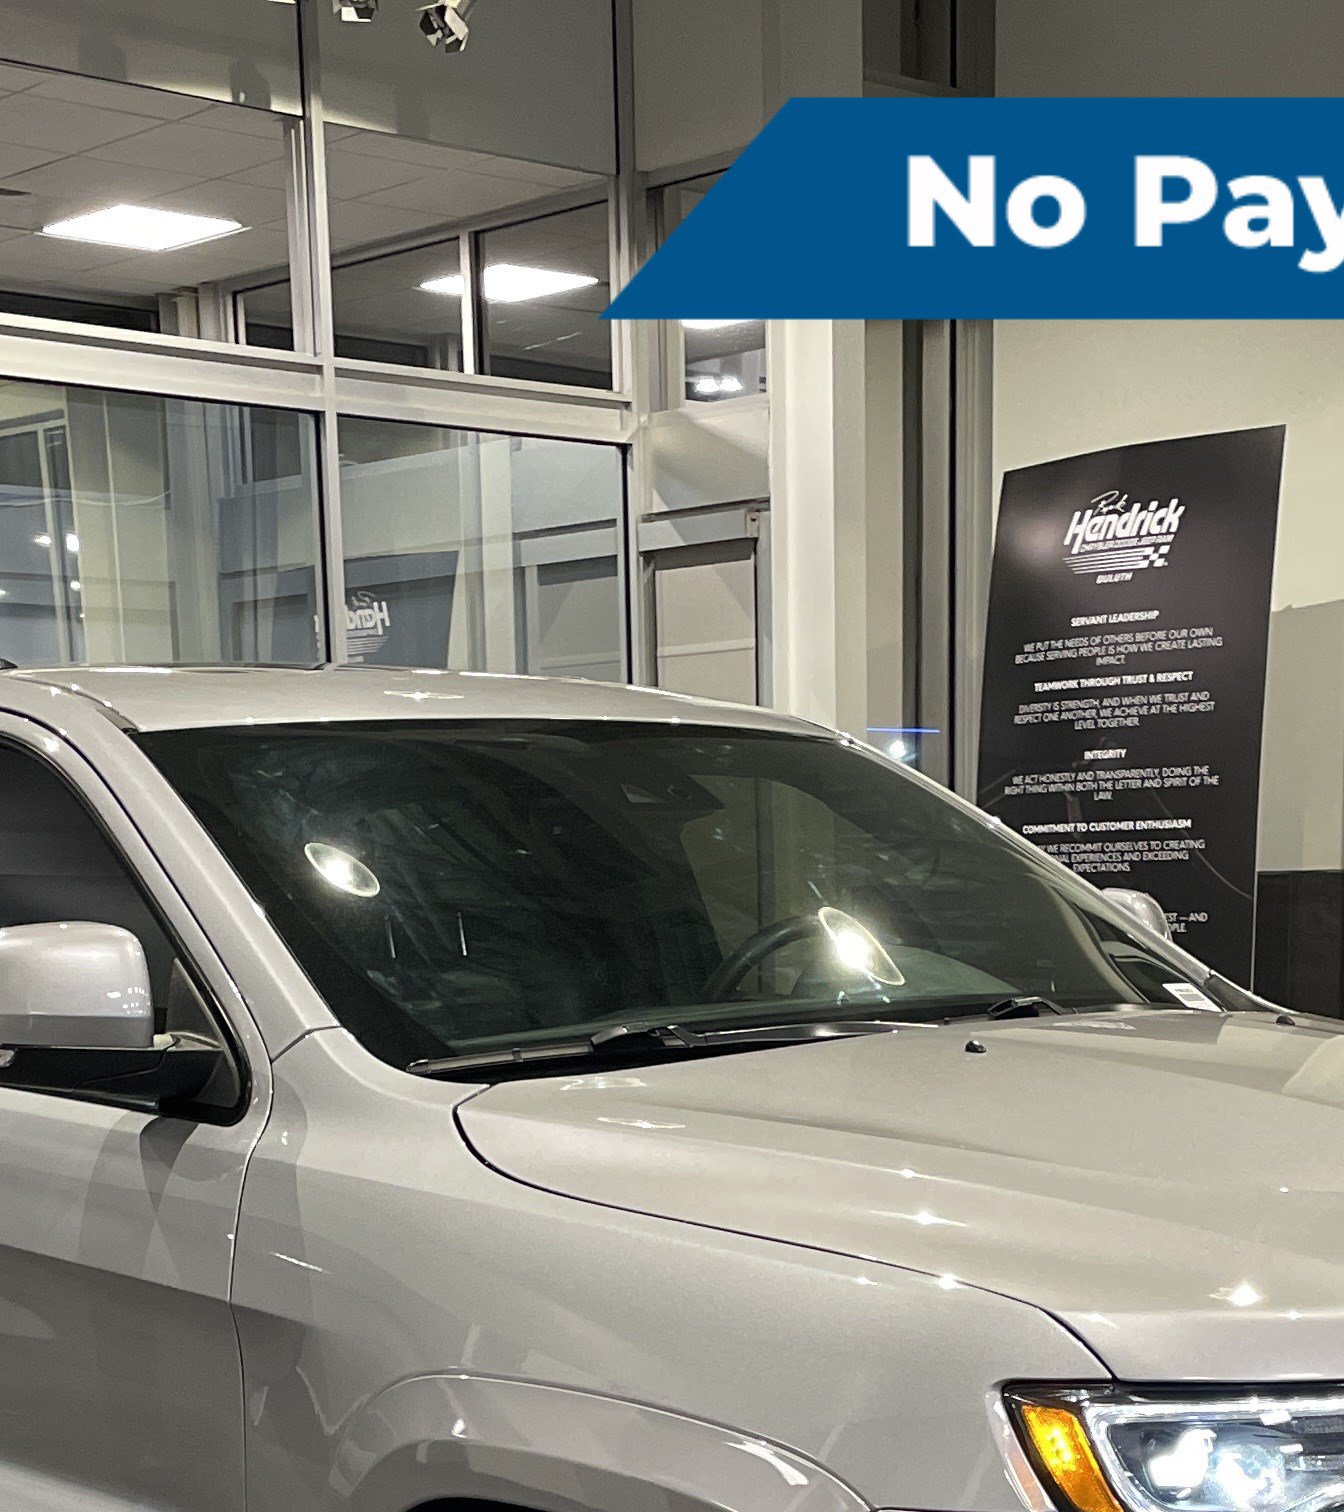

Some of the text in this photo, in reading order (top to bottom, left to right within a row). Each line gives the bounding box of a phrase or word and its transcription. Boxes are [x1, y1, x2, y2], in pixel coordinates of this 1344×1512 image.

[1063, 498, 1185, 554] Hendrick
[1071, 610, 1159, 627] SERVANT LEADERSHIP
[1090, 636, 1101, 645] OF
[1102, 633, 1134, 644] OTHERS
[1135, 630, 1167, 642] BEFORE
[1168, 629, 1188, 639] OUR
[1190, 627, 1214, 638] OWN
[1046, 649, 1077, 660] SERVING
[1078, 646, 1106, 657] PEOPLE
[1108, 645, 1115, 654] IS
[1116, 643, 1138, 653] HOW
[1139, 642, 1153, 652] WE
[1155, 639, 1186, 651] CREATE
[1188, 637, 1223, 648] LASTING
[1034, 671, 1194, 692] TEAMWORK THROUGH TRUST & RESPECT
[1053, 701, 1060, 710] IS
[1102, 697, 1120, 706] AND
[1122, 695, 1147, 705] WHEN
[1149, 694, 1162, 703] WE
[1164, 692, 1189, 702] TRUST
[1190, 691, 1210, 701] AND
[1043, 712, 1059, 722] ONE
[1100, 708, 1113, 717] WE
[1114, 705, 1148, 716] ACHIEVE
[1150, 704, 1160, 714] AT
[1163, 704, 1178, 713] THE
[1179, 701, 1215, 712] HIGHEST
[1074, 720, 1095, 730] LEVEL
[1084, 749, 1127, 760] INTEGRITY
[1012, 775, 1023, 784] WE
[1077, 771, 1095, 780] AND
[1162, 766, 1192, 777] DOING
[1194, 766, 1210, 775] THE
[1076, 782, 1097, 791] BOTH
[1099, 781, 1113, 790] THE
[1115, 779, 1142, 789] LETTER
[1143, 778, 1162, 788] AND
[1163, 777, 1187, 787] SPIRIT
[1189, 776, 1201, 786] OF
[1203, 775, 1220, 785] THE
[1022, 819, 1192, 834] COMMITMENT TO CUSTOMER ENTHUSIASM
[1047, 844, 1058, 853] WE
[1060, 843, 1102, 852] RECOMMIT
[1104, 841, 1148, 852] OURSELVES
[1150, 841, 1161, 850] TO
[1163, 839, 1206, 849] CREATING
[1071, 852, 1122, 862] EXPERIENCES
[1123, 852, 1141, 860] AND
[1143, 850, 1189, 860] EXCEEDING
[1188, 912, 1208, 922] AND
